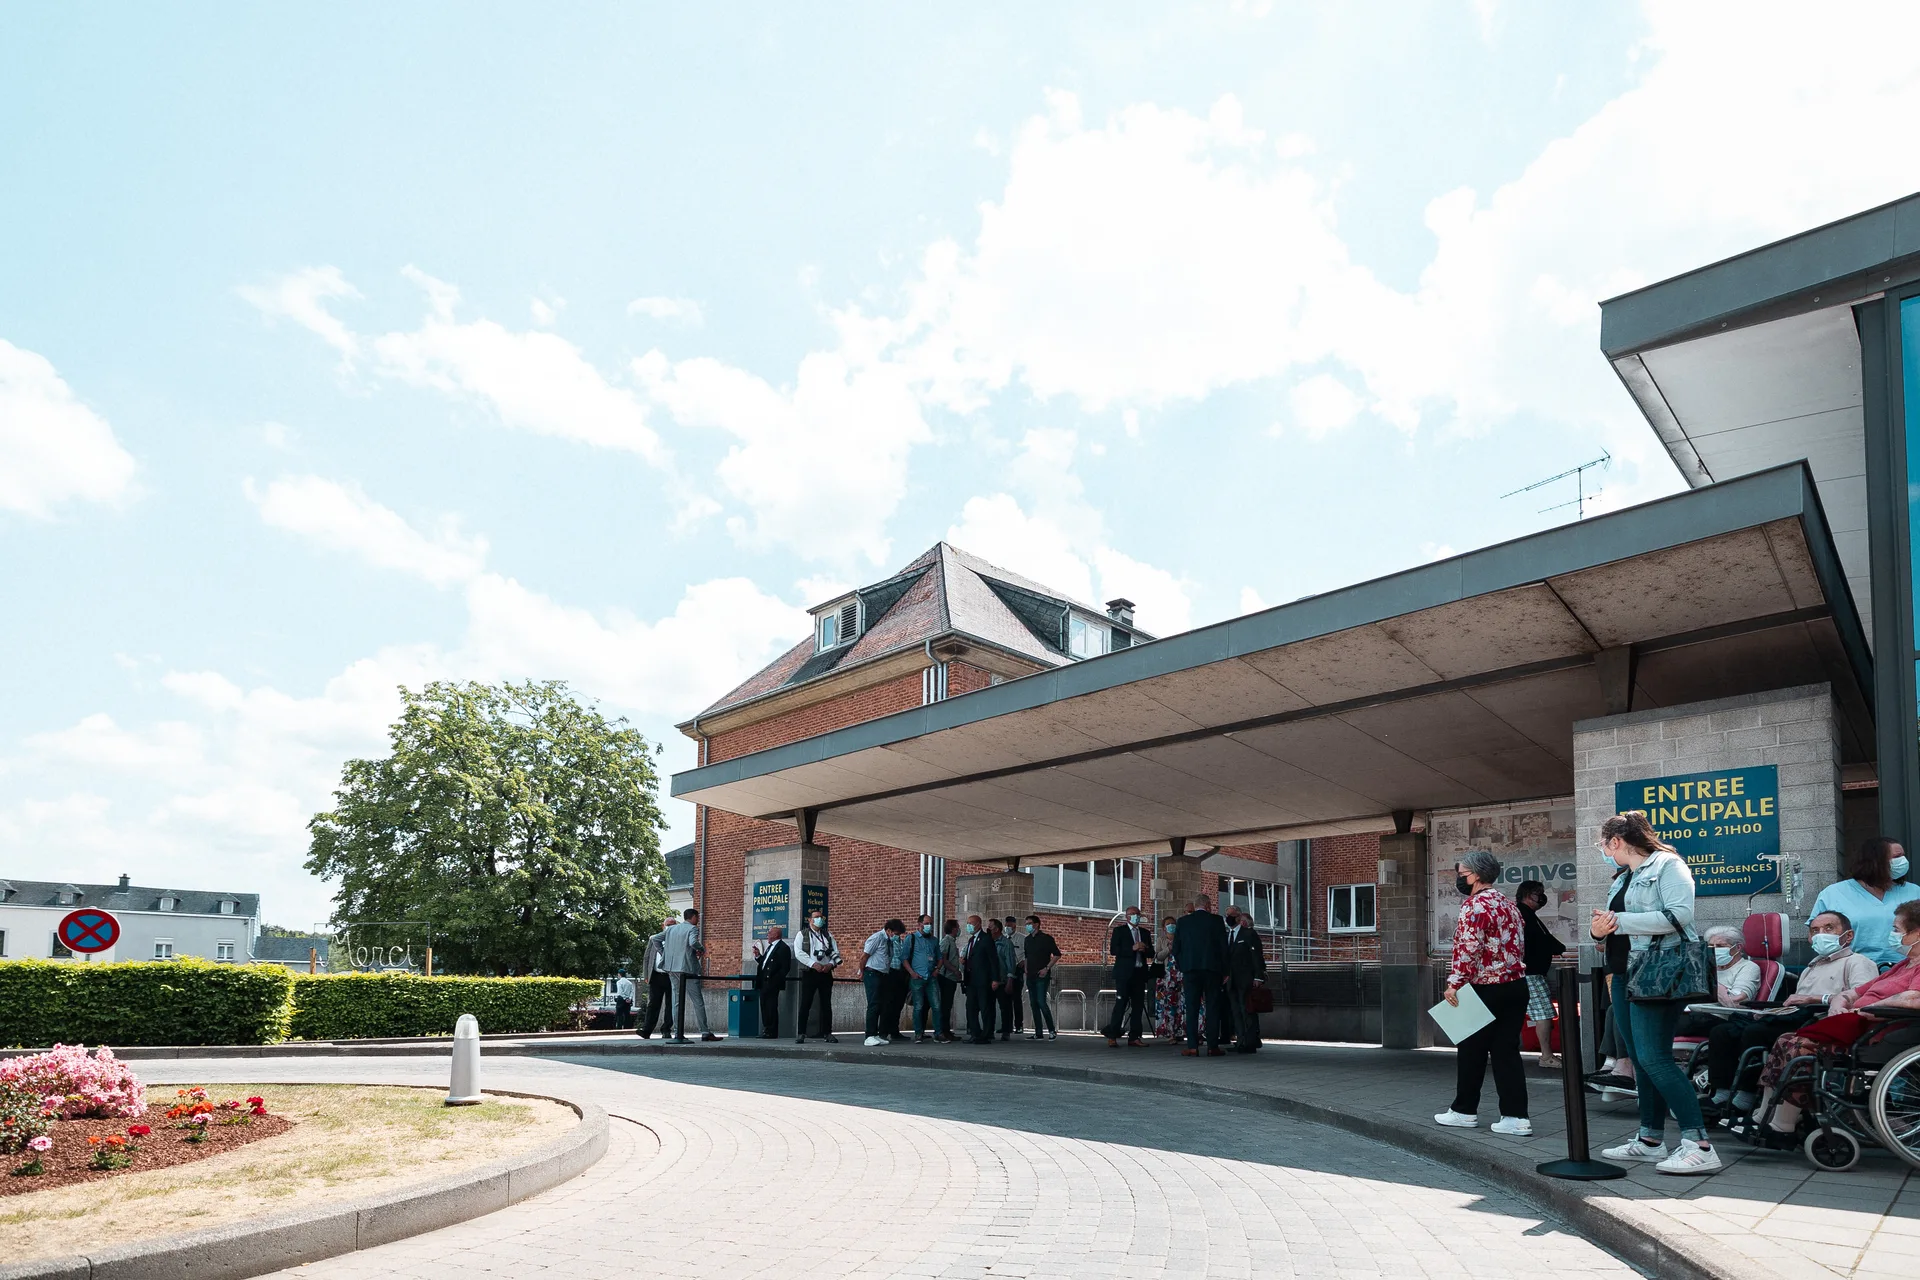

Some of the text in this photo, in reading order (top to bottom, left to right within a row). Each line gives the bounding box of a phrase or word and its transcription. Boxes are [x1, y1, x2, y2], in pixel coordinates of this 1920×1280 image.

[1643, 777, 1744, 805] ENTREE
[1620, 797, 1774, 826] INCIPALE
[1698, 828, 1707, 837] à
[1714, 823, 1762, 836] 21H00
[1687, 854, 1717, 864] NUIT
[1711, 863, 1772, 875] URGENCES
[759, 884, 783, 895] ENTREE
[753, 894, 789, 905] PRINCIPALE
[320, 932, 418, 967] Merci
